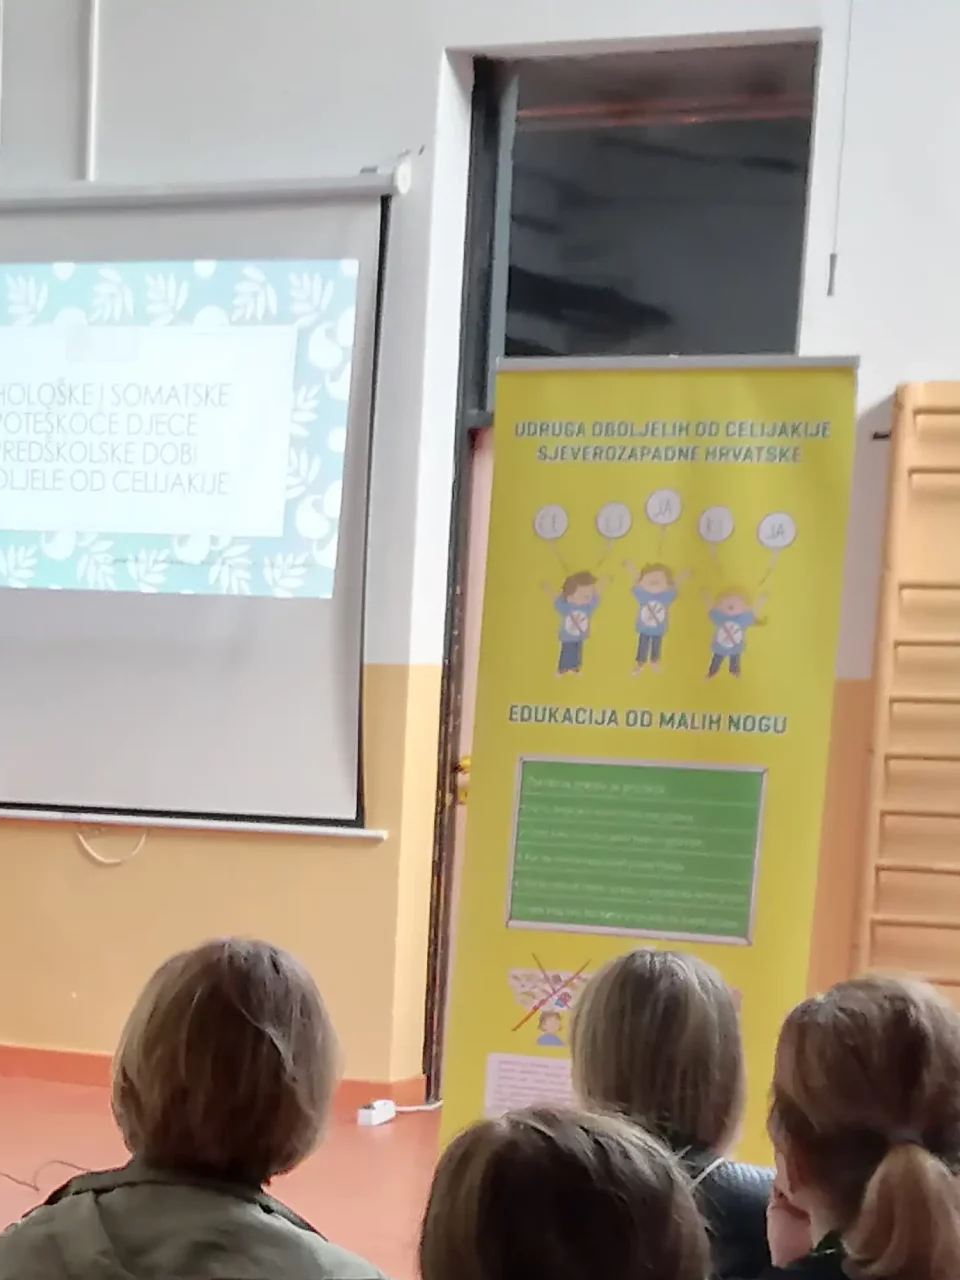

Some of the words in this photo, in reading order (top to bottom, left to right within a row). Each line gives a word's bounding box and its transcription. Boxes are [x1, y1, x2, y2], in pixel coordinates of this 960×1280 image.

[111, 382, 232, 407] SOMATSKE
[126, 413, 199, 437] DJECE
[514, 420, 585, 438] UDRUGA
[591, 420, 690, 438] OBOLJELIH
[695, 421, 720, 438] OD
[725, 421, 831, 439] CELIJAKIJE
[142, 442, 199, 465] DOBI
[537, 444, 700, 462] SJEVEROZAPADNE
[704, 446, 802, 463] HRVATSKE
[70, 469, 106, 492] OD
[112, 470, 231, 495] CELIJAKIJE
[508, 704, 618, 727] EDUKACIJA
[625, 709, 653, 728] OD
[659, 711, 722, 732] MALIH
[727, 714, 788, 735] NOGU
